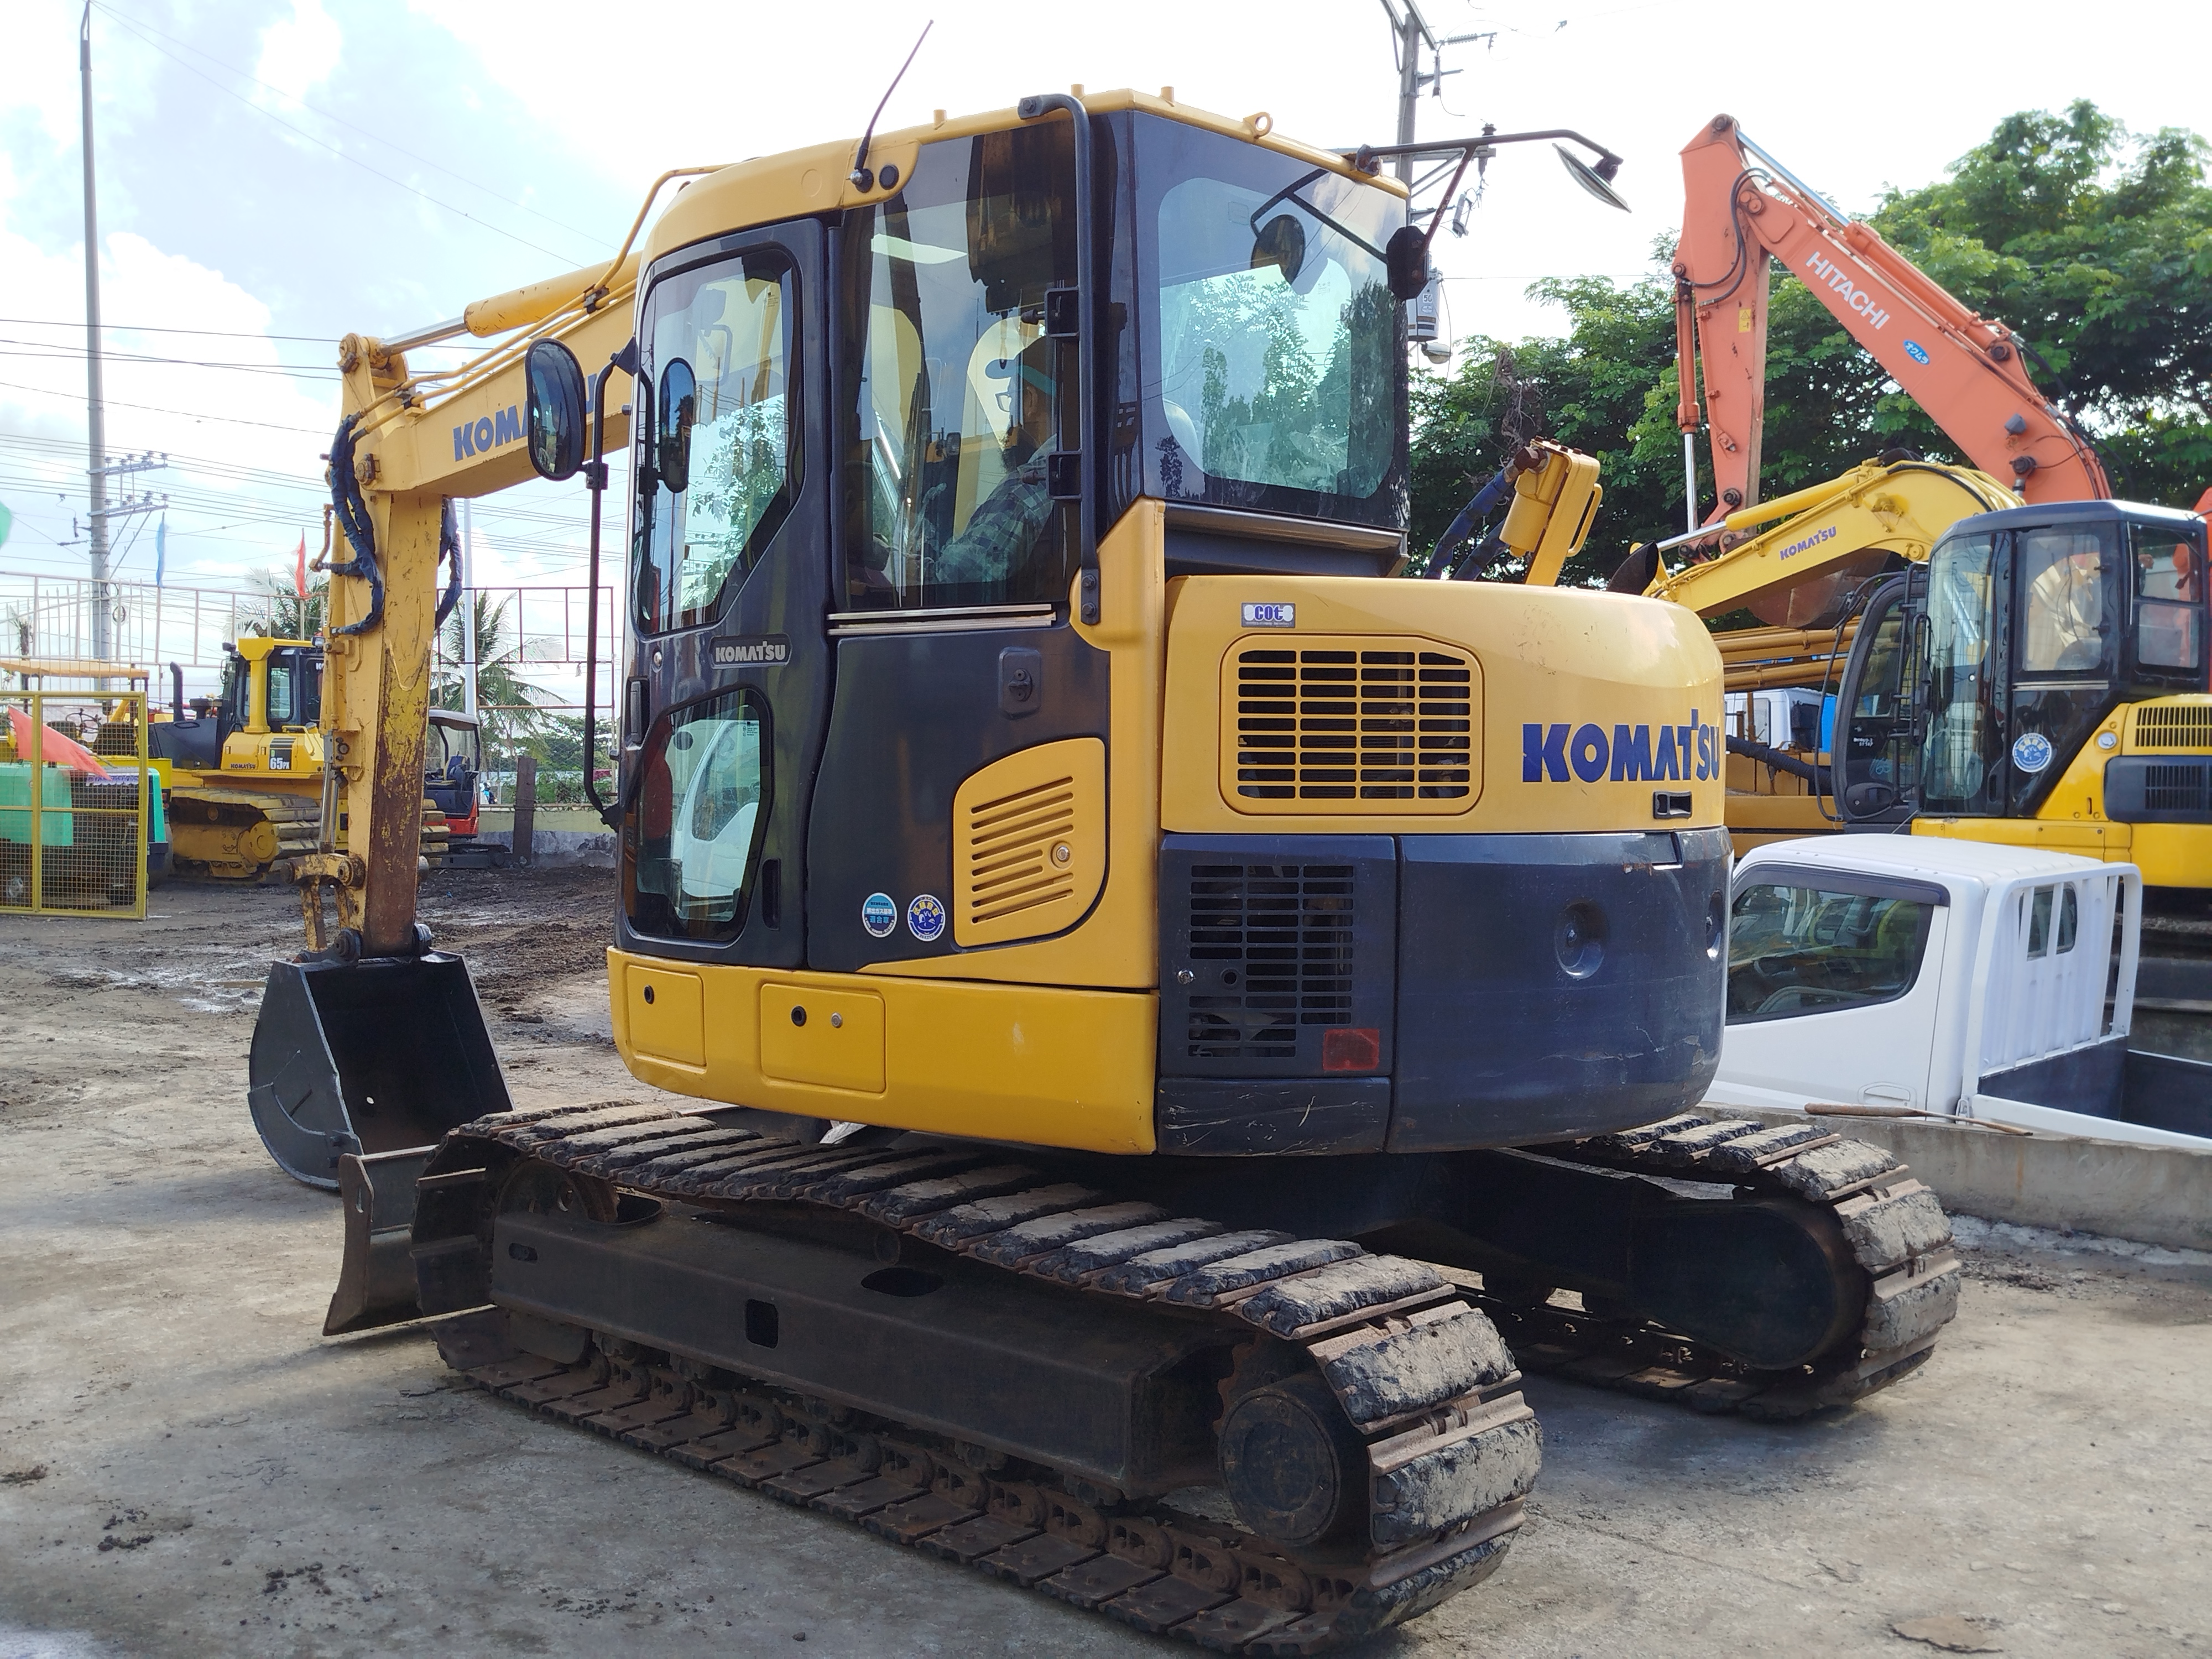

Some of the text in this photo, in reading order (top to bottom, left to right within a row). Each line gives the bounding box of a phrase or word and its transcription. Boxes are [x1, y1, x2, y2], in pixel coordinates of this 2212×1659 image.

[1806, 251, 1890, 330] HITACHI
[1905, 342, 1929, 364] オクムラ
[1780, 526, 1836, 560] KOMATSU
[716, 640, 786, 662] KOMATSU
[1522, 708, 1719, 782] KOMATSU
[270, 758, 290, 769] 65PX
